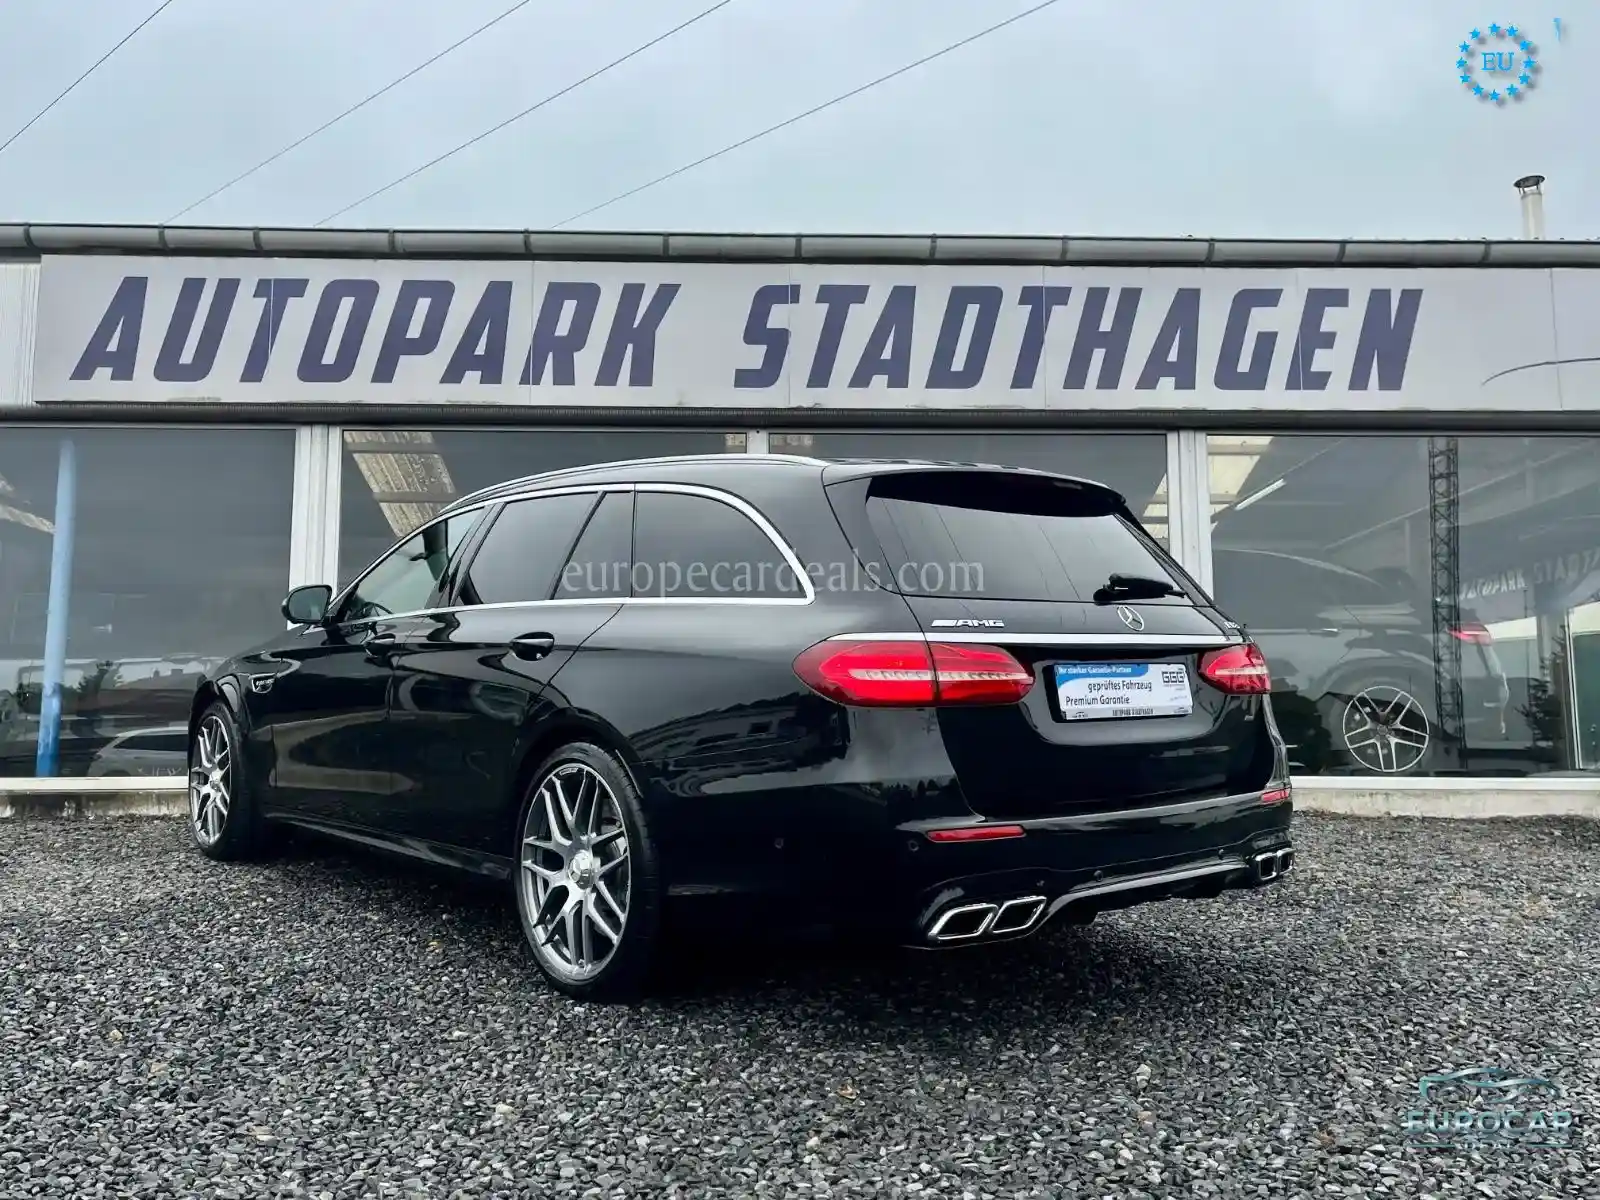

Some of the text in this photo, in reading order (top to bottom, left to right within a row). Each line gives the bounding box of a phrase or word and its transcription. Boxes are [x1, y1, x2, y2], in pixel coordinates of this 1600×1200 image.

[70, 275, 1423, 391] AUTOPARK STADTHAGEN
[956, 619, 1005, 628] AMG
[1088, 680, 1121, 693] geprüftes
[1122, 680, 1152, 691] Fahrzeug
[1065, 694, 1130, 706] Premium Garantie
